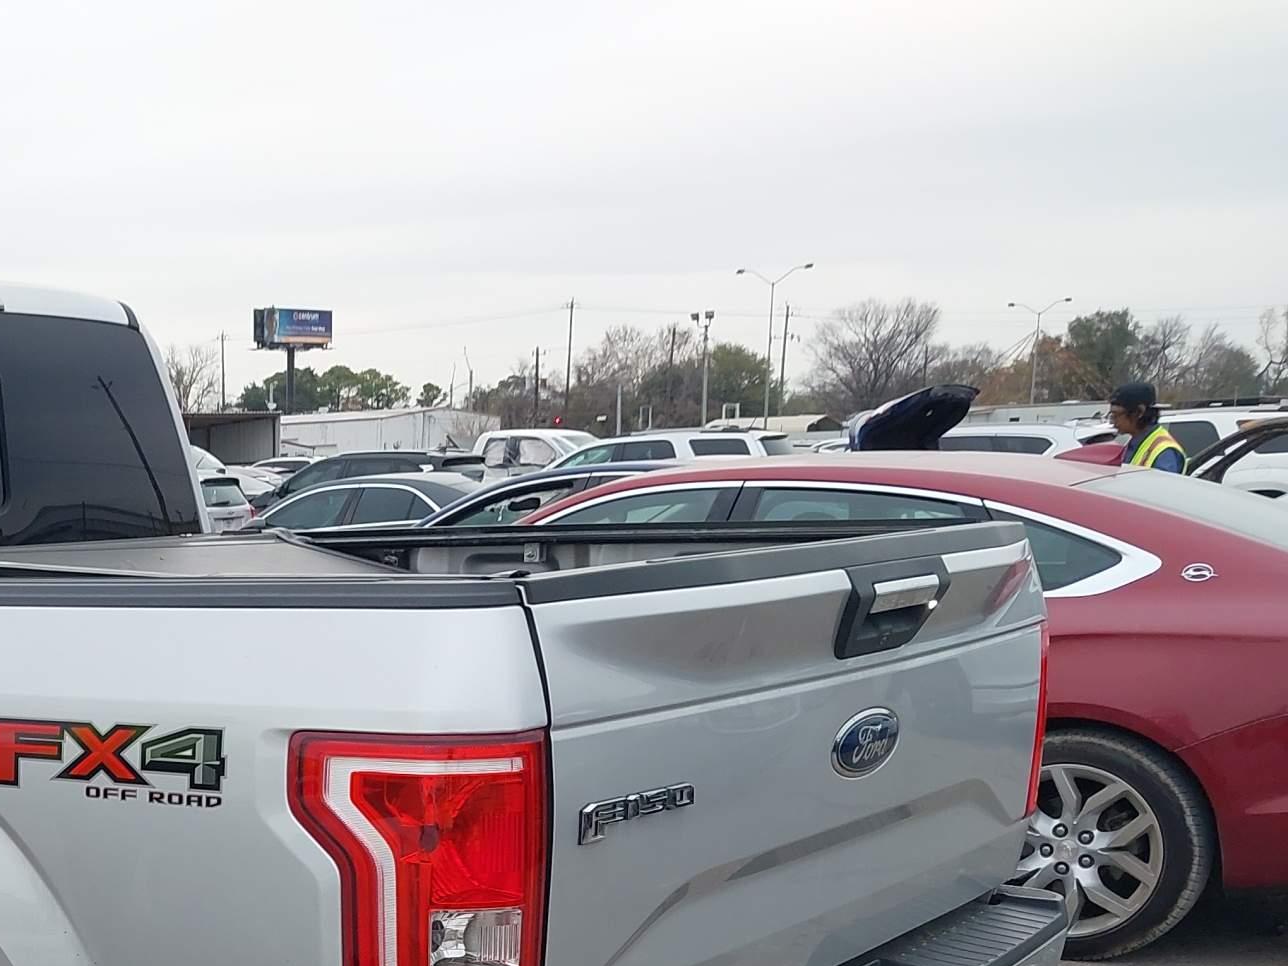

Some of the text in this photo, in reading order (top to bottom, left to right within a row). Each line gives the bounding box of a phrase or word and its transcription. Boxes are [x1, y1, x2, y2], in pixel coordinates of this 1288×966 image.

[853, 723, 889, 763] Ford
[85, 786, 223, 808] OFF ROAD
